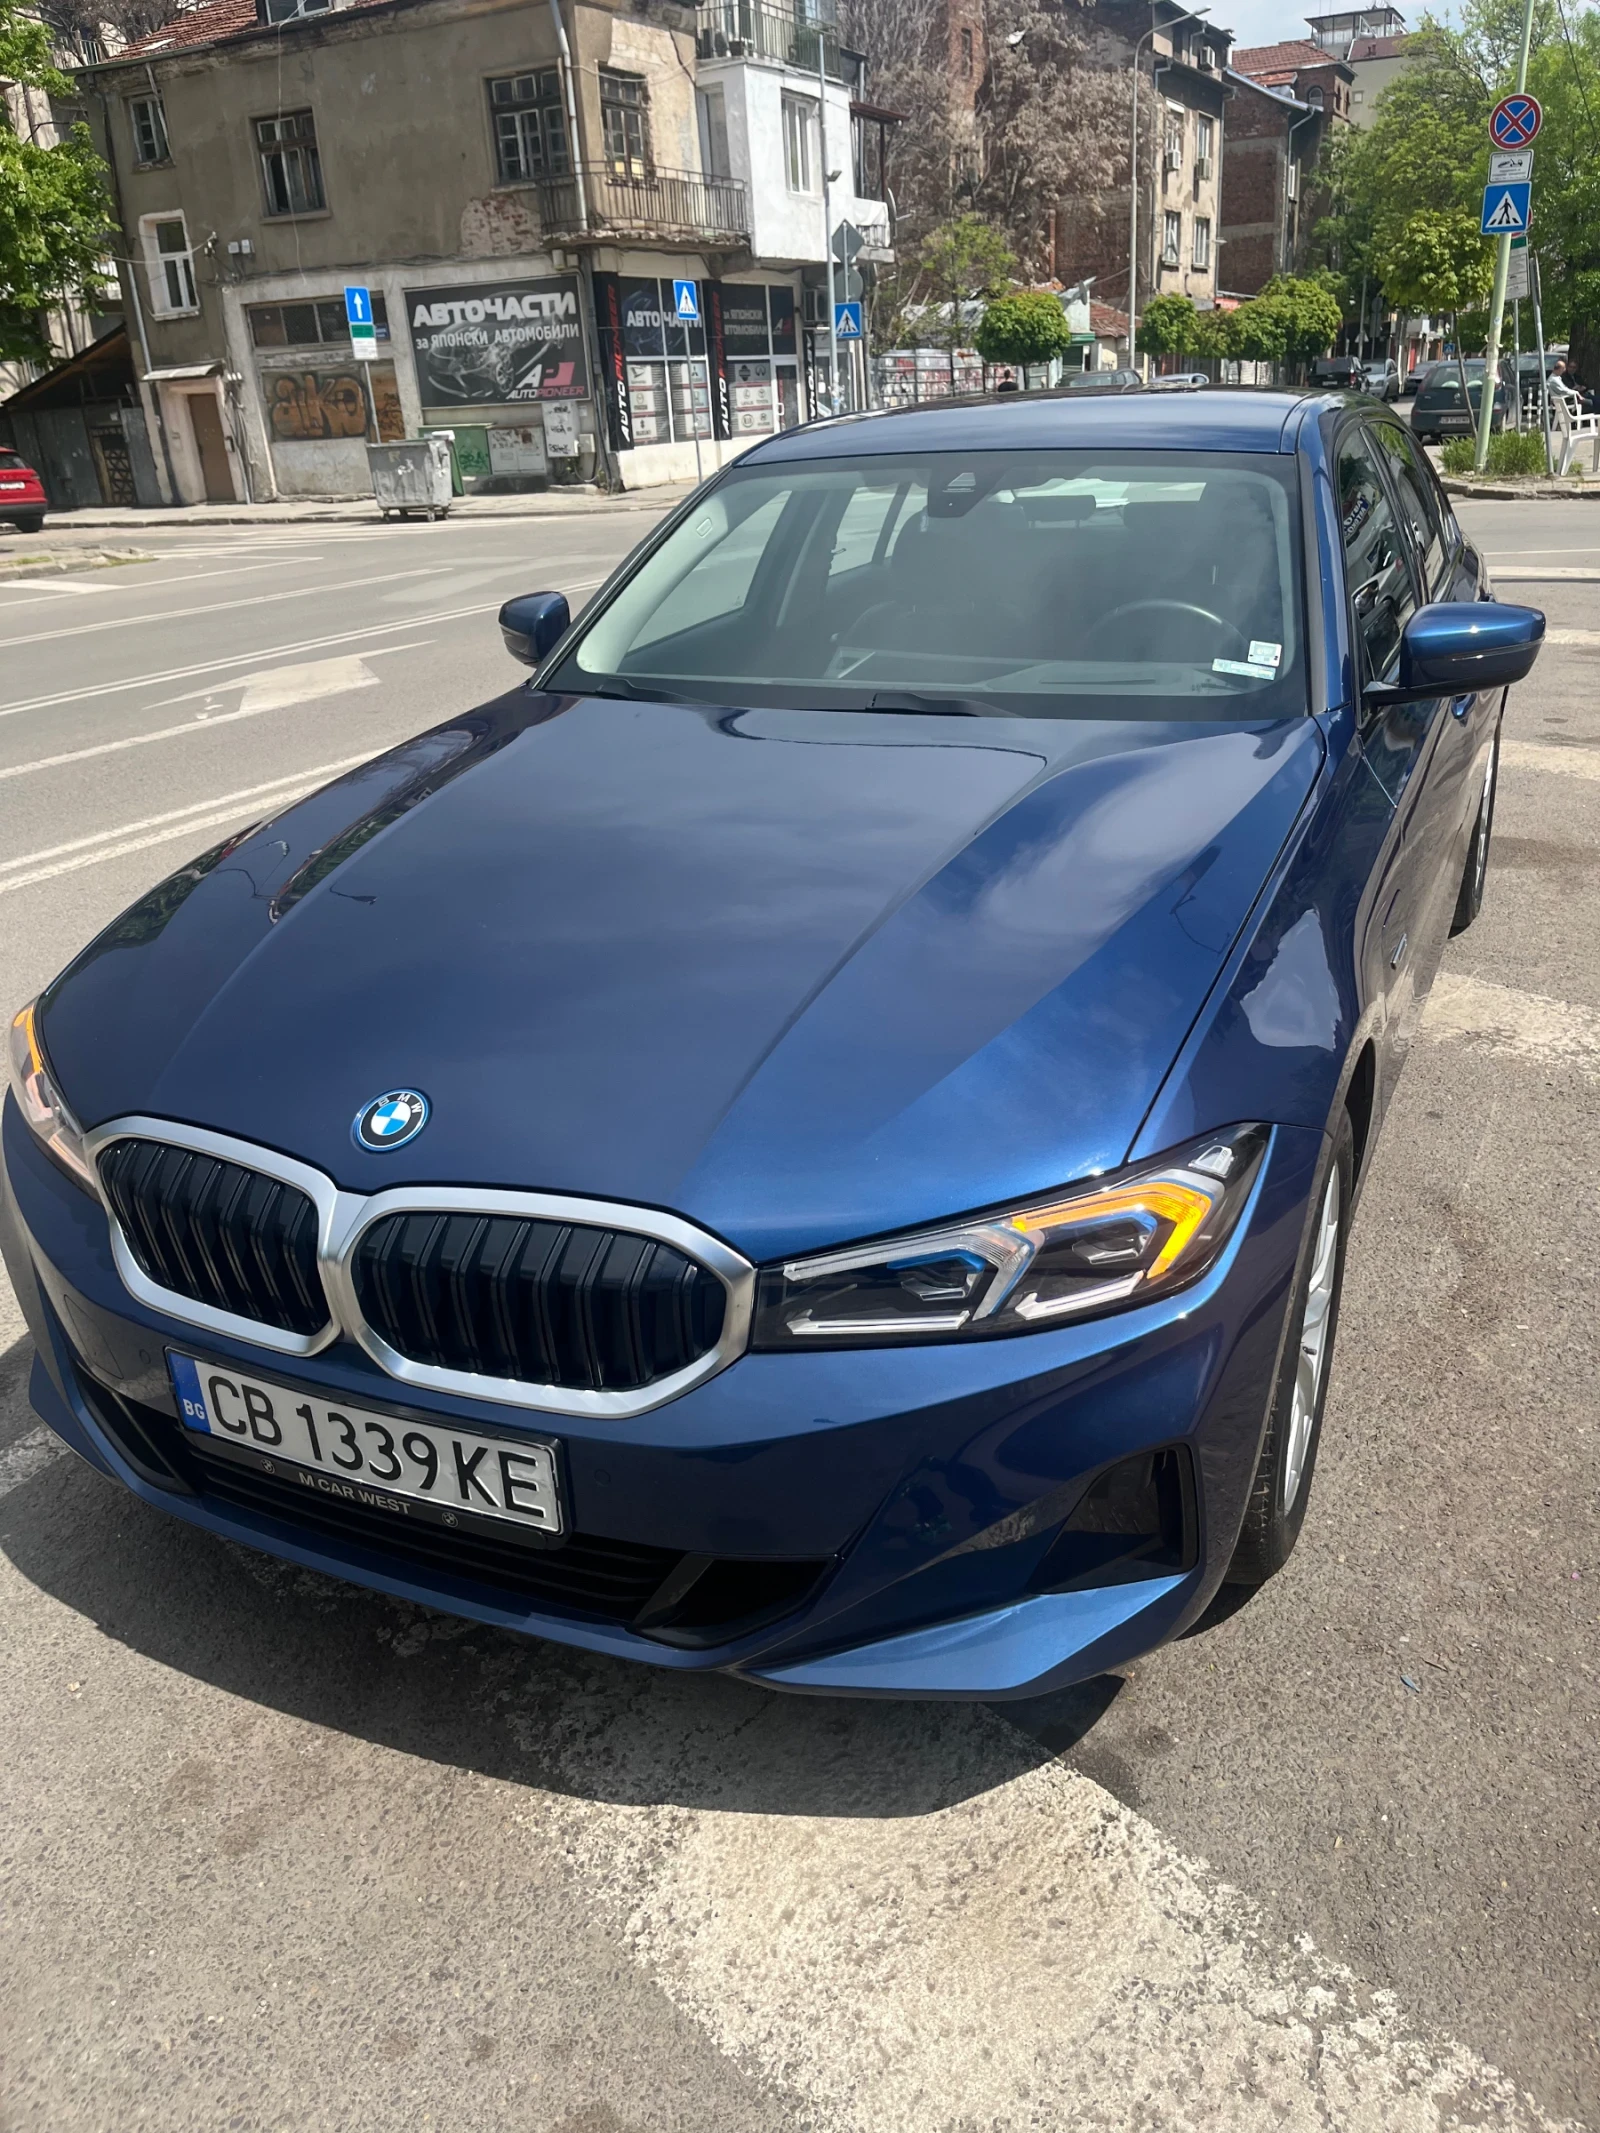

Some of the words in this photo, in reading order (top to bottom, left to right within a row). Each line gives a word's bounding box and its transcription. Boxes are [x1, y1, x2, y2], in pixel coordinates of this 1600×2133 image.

[413, 291, 576, 328] АВТОЧАСТИ
[416, 338, 428, 350] за
[431, 332, 488, 349] ЯПОНСКИ
[494, 323, 580, 344] АВТОМОБИЛИ
[506, 386, 584, 400] AUTOPIONEER
[378, 1093, 422, 1114] BMW
[183, 1398, 205, 1420] BG
[208, 1375, 283, 1446] CB
[295, 1403, 438, 1490] 1339
[452, 1440, 545, 1518] KE
[298, 1472, 315, 1487] M
[318, 1479, 355, 1499] CAR
[358, 1489, 410, 1514] WEST
